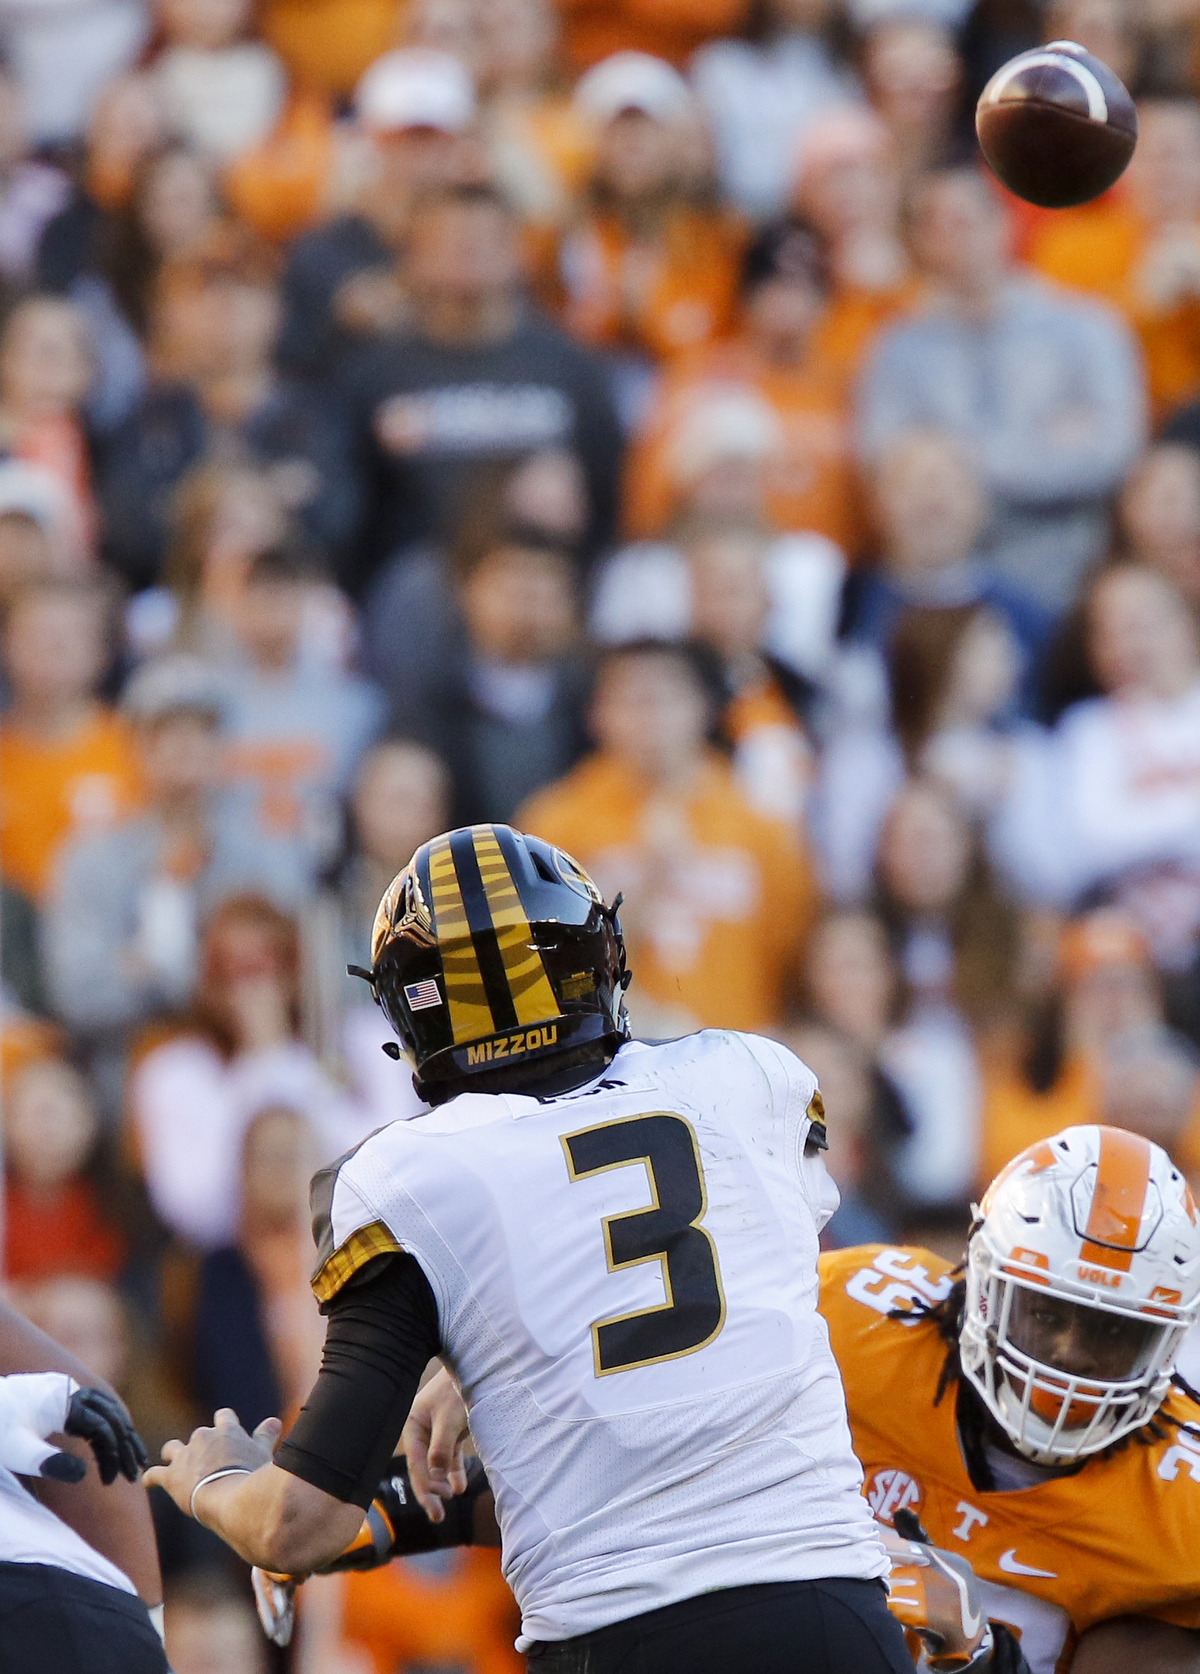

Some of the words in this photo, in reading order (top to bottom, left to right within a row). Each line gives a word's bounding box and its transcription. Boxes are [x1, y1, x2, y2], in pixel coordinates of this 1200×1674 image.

[467, 1025, 558, 1066] MIZZOU
[558, 1111, 727, 1378] 3
[845, 1249, 954, 1327] 39
[1077, 1265, 1122, 1288] VOLS
[953, 1500, 989, 1542] T
